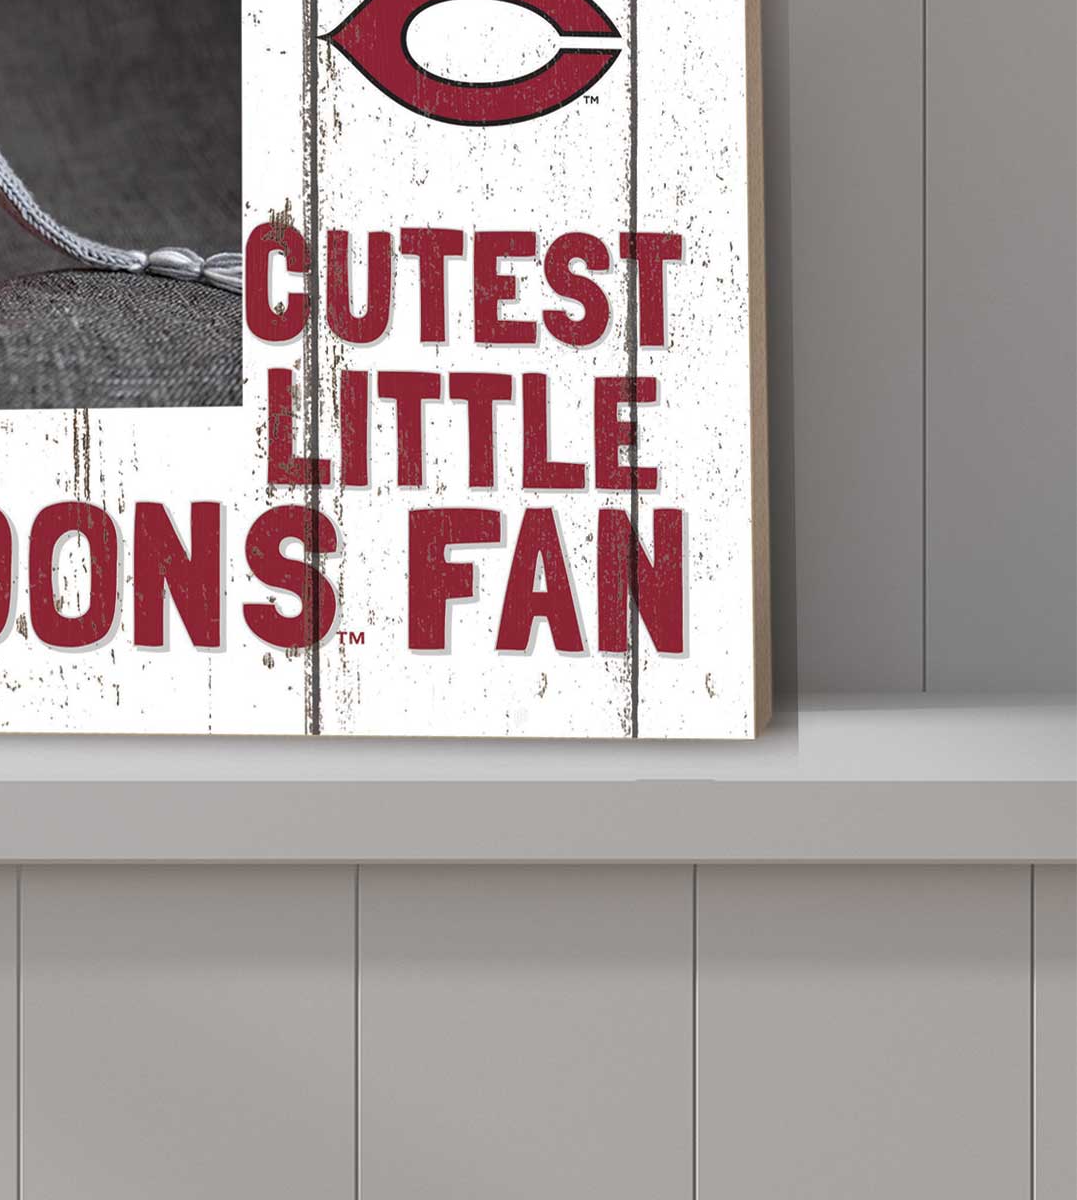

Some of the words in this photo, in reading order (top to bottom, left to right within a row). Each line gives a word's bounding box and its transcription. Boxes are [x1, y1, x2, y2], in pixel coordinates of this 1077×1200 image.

[244, 222, 684, 348] CUTEST
[266, 367, 659, 492] LITTLE
[408, 506, 685, 655] FAN
